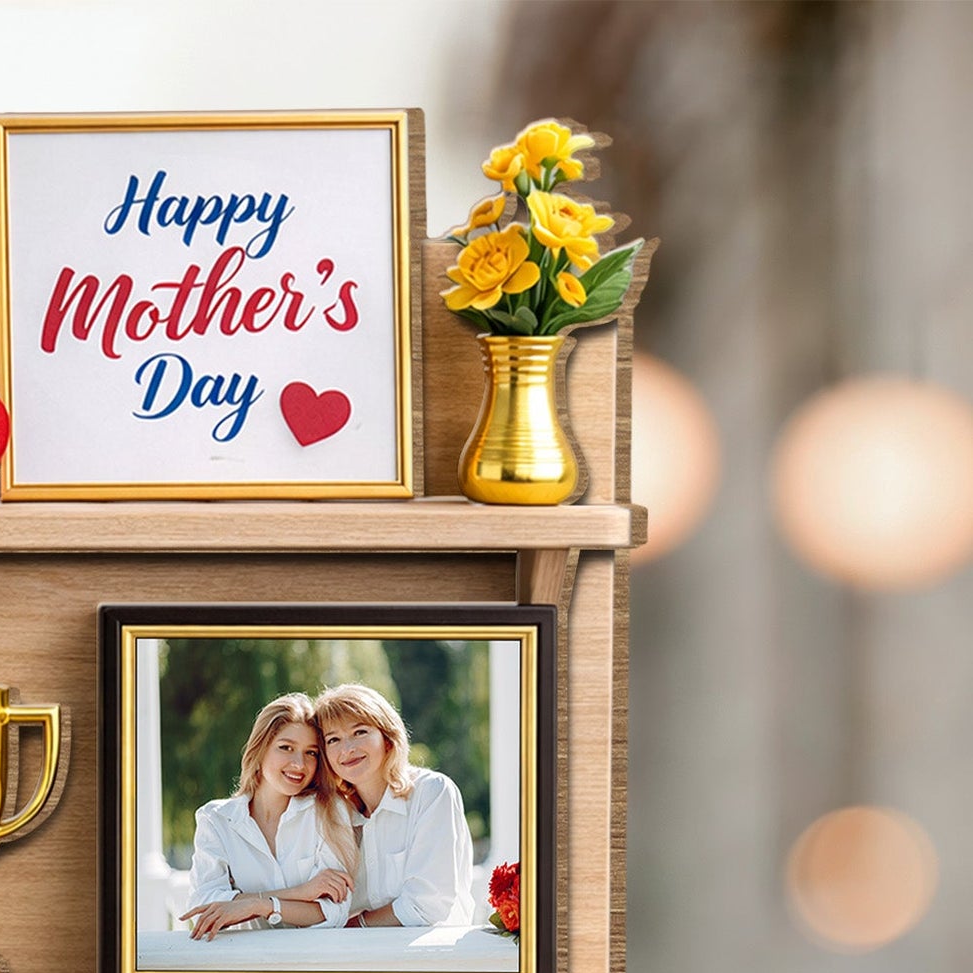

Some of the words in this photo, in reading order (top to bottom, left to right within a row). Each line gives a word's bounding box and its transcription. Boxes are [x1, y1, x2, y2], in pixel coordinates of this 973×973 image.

[104, 170, 295, 259] Happy
[40, 246, 359, 359] Mother's
[132, 353, 265, 442] Day
